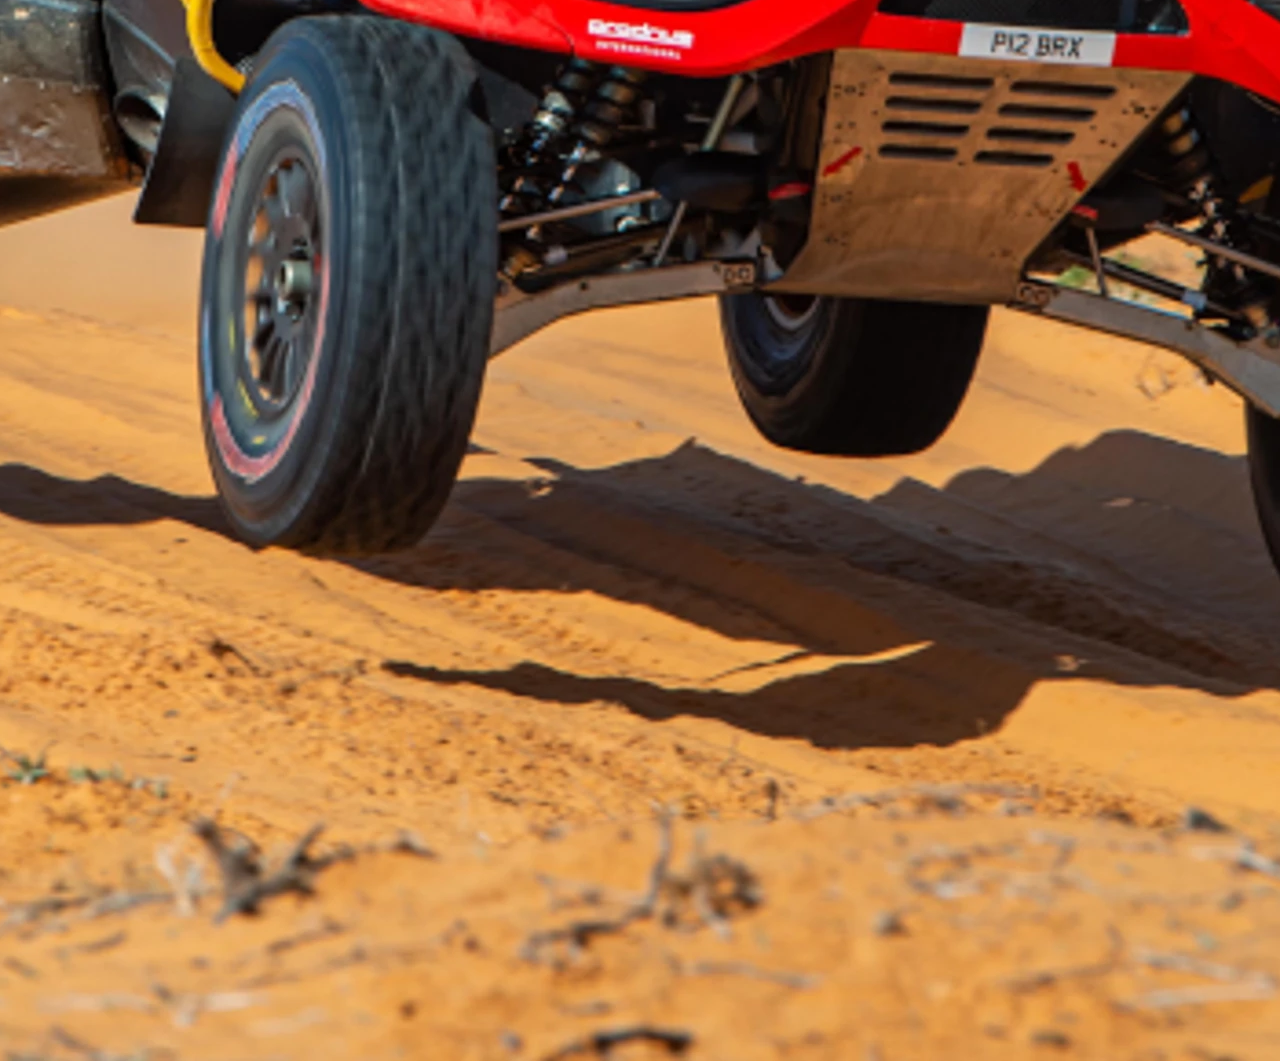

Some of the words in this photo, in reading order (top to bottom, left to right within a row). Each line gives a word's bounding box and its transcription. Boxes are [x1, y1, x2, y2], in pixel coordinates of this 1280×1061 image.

[588, 19, 694, 49] prodrive
[990, 30, 1032, 57] P12
[1035, 33, 1084, 59] BRX
